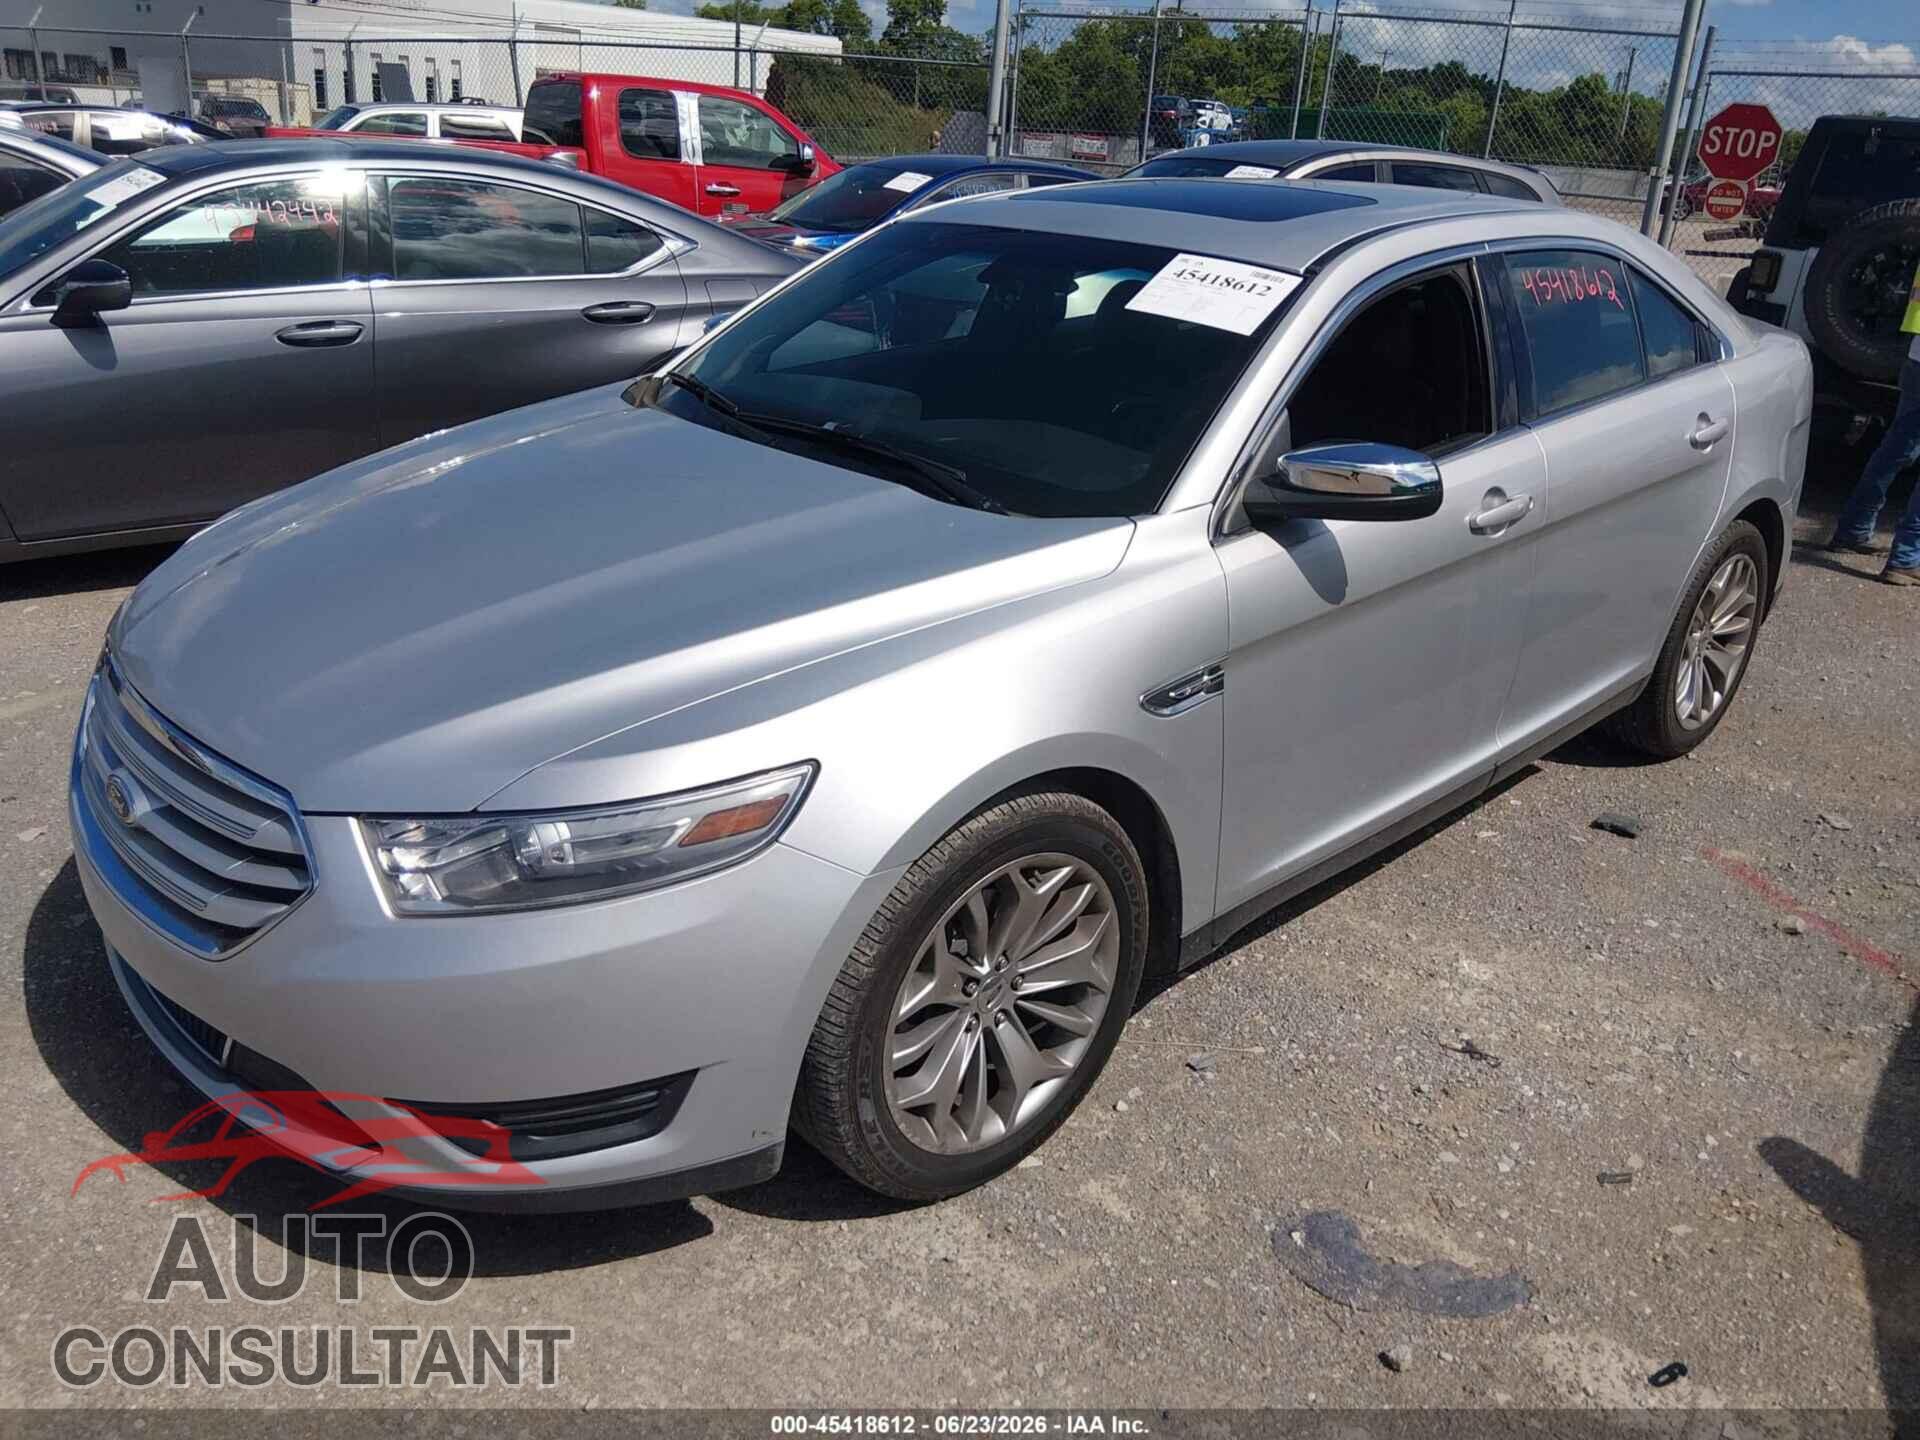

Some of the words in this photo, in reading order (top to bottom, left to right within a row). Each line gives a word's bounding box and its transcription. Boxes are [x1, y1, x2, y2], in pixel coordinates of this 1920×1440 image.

[1704, 126, 1777, 159] STOP
[1712, 188, 1724, 196] DO
[1725, 189, 1741, 197] NOT
[1173, 268, 1273, 297] 45418612
[1521, 266, 1625, 311] 45418612
